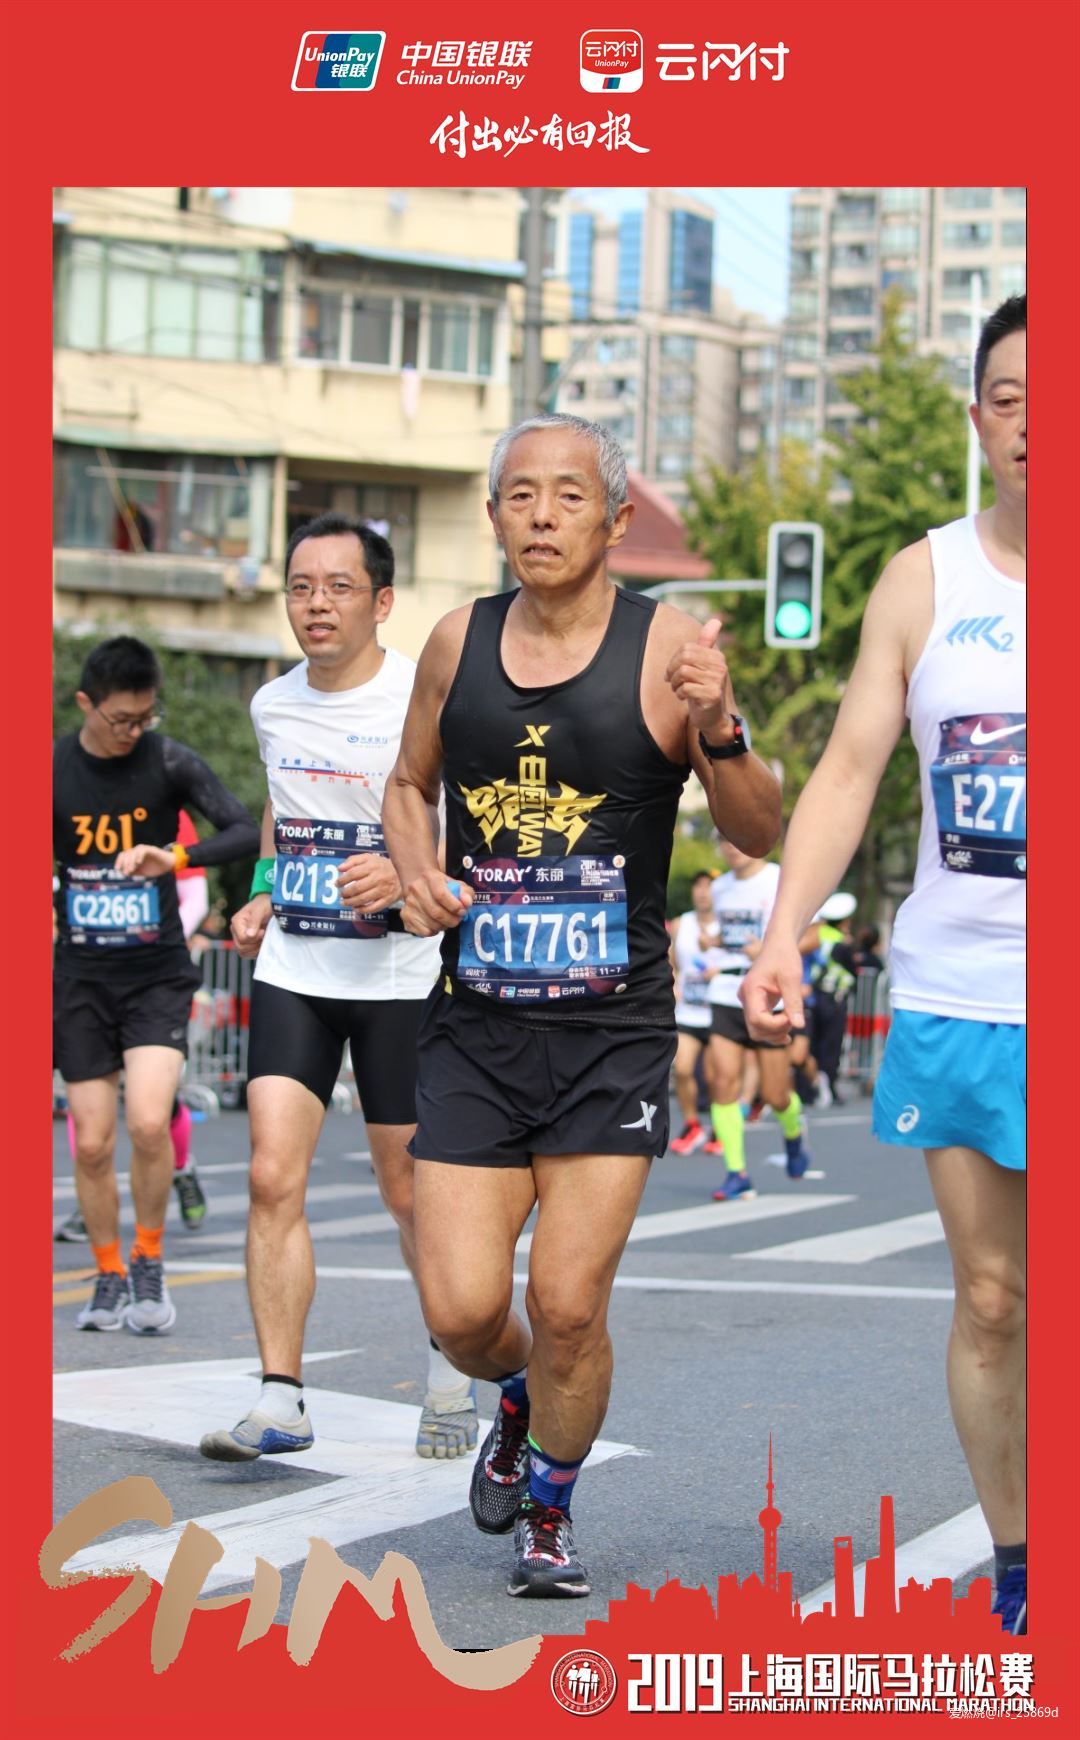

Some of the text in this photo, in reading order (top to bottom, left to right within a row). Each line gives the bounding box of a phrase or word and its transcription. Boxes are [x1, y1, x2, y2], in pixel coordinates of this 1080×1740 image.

[952, 773, 1026, 832] E27
[280, 860, 340, 906] C213
[535, 868, 564, 882] 东丽
[73, 893, 150, 926] C22661
[473, 910, 609, 963] C17761
